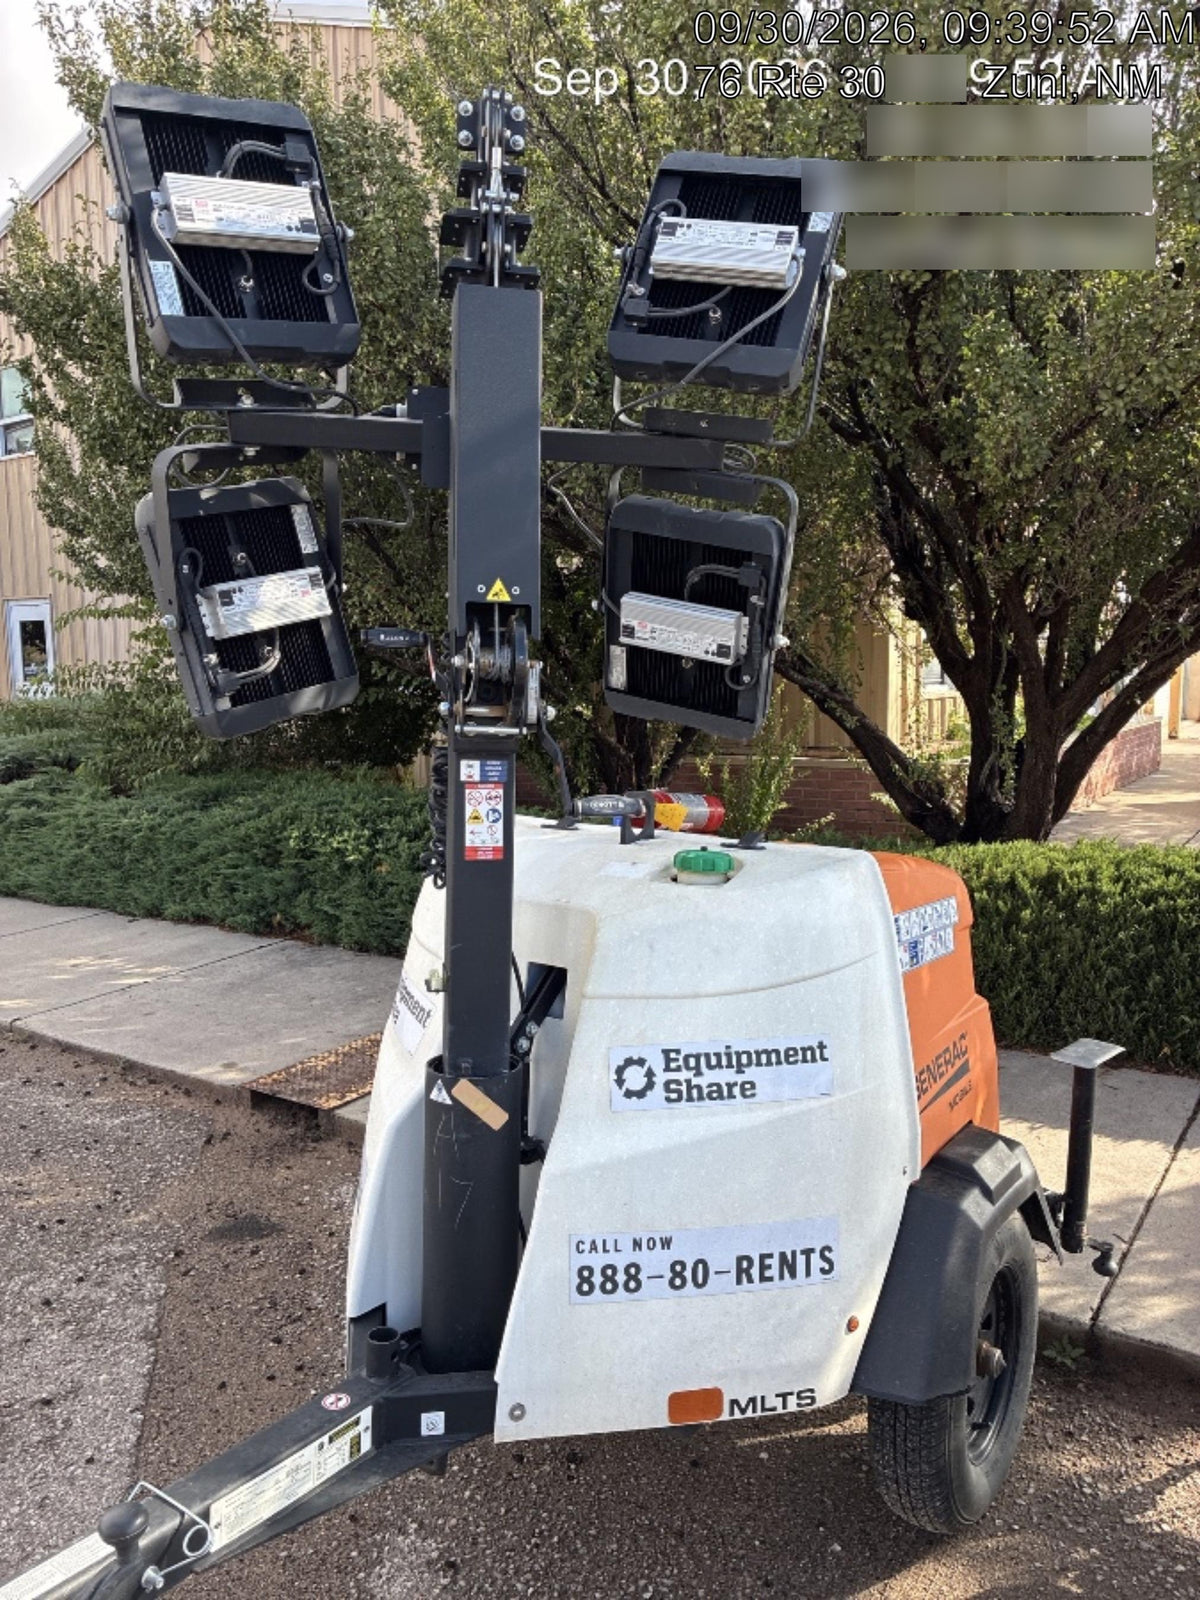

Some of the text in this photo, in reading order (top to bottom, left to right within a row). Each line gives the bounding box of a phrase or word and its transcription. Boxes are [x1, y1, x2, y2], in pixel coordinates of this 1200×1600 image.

[661, 1040, 829, 1077] Equipment
[662, 1079, 757, 1103] Share
[575, 1236, 673, 1254] CALL NOW
[575, 1245, 836, 1297] 888-80-RENTS
[728, 1388, 817, 1417] MLTS
